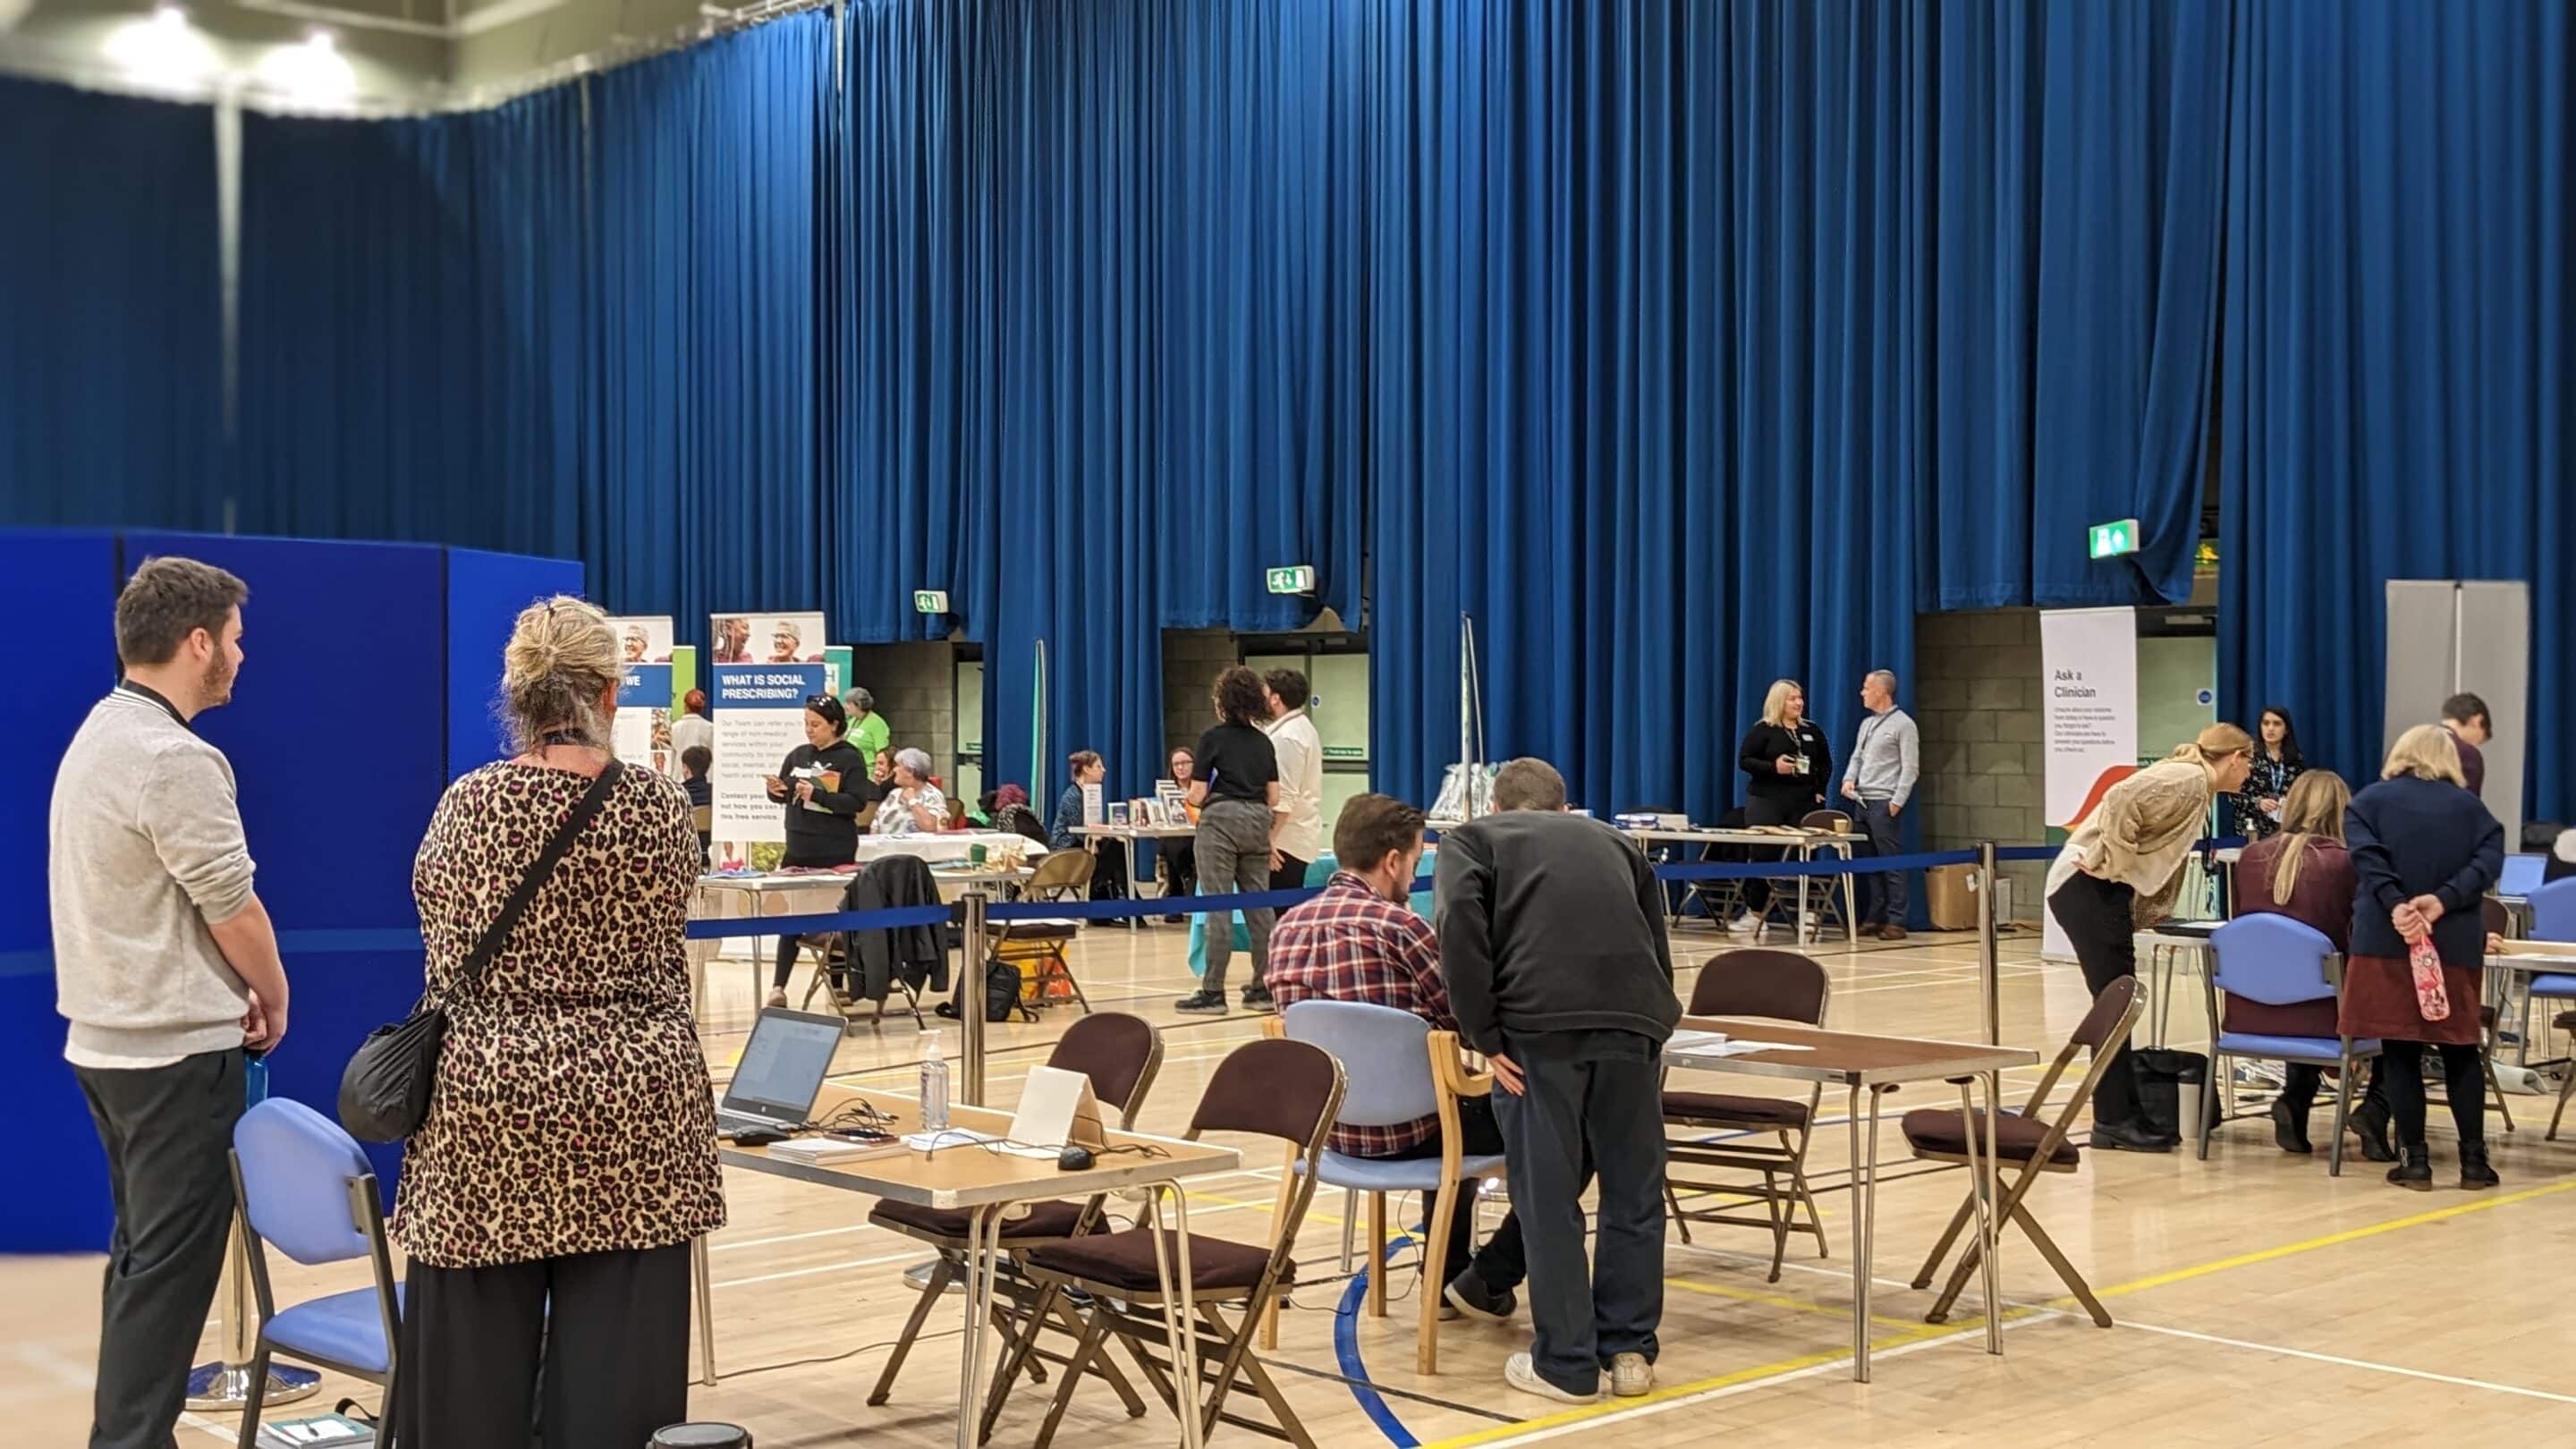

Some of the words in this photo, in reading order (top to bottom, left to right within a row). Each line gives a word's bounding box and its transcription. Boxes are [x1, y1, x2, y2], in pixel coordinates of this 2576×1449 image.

[624, 675, 641, 686] WE
[722, 674, 752, 686] WHAT
[754, 674, 766, 686] IS
[767, 674, 807, 686] SOCIAL
[2054, 668, 2074, 681] Ask
[2076, 672, 2082, 681] a
[722, 688, 799, 699] PRESCRIBING?
[2054, 685, 2097, 698] Clinician
